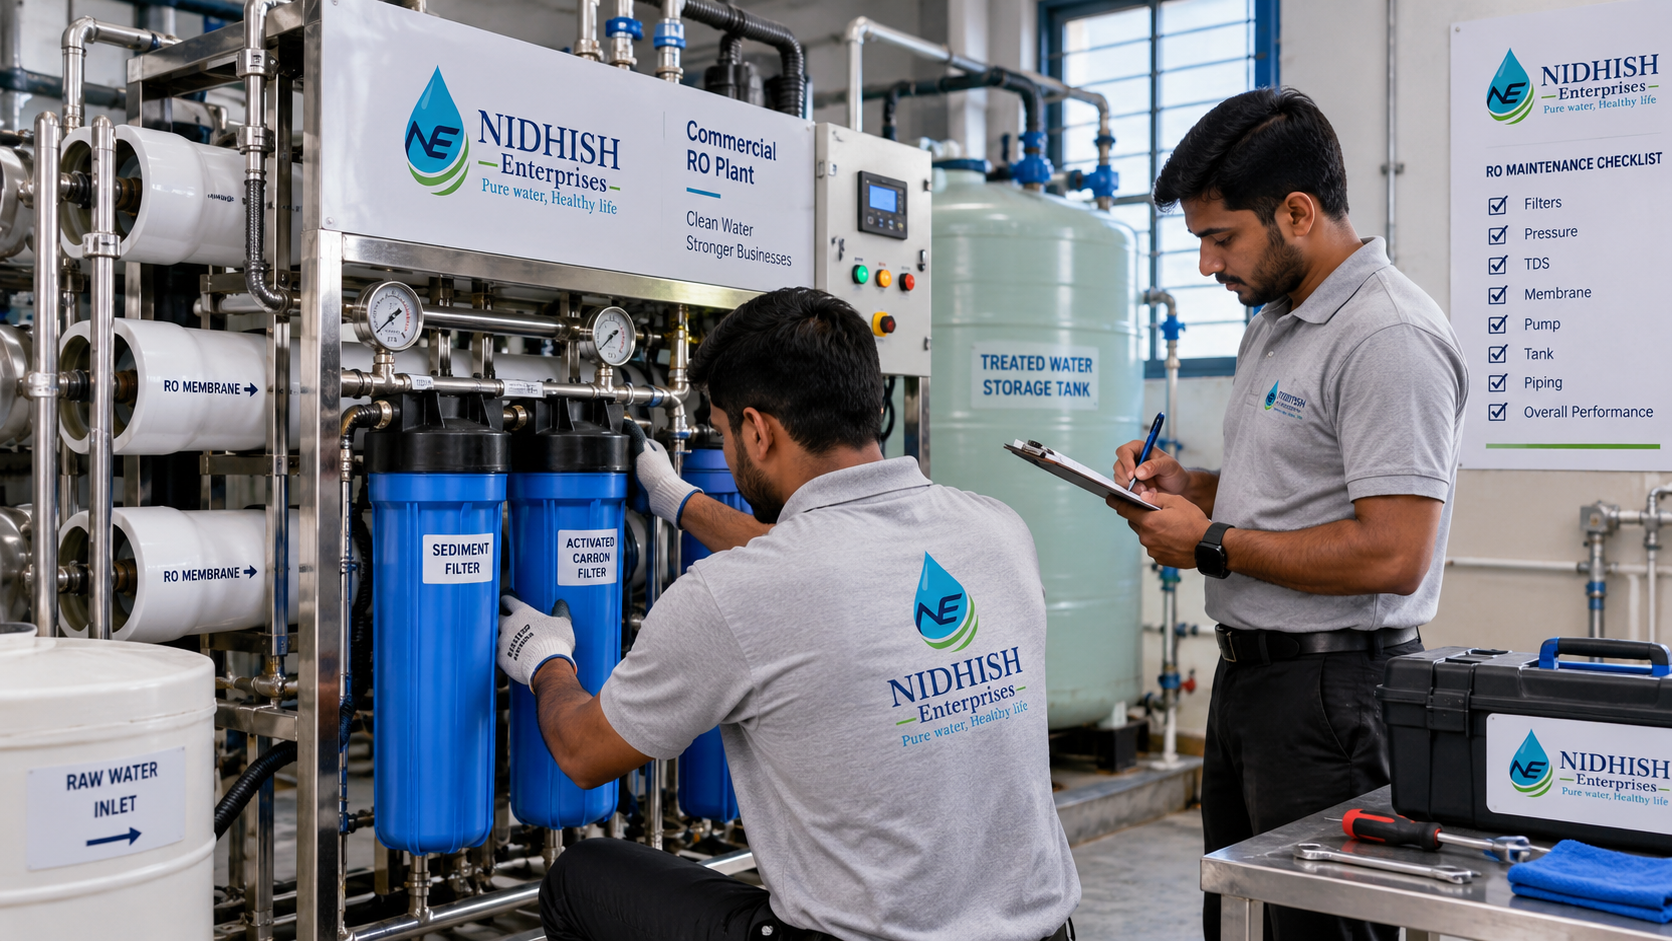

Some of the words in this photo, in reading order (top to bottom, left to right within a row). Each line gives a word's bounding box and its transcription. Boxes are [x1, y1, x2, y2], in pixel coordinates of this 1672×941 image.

[1541, 53, 1659, 86] NIDHISH
[1558, 81, 1646, 100] Enterprises
[1543, 104, 1565, 114] Pure
[1568, 102, 1596, 112] water,
[1599, 97, 1637, 109] Healthy
[1640, 95, 1657, 105] life
[478, 109, 620, 170] NIDHISH
[687, 120, 777, 161] Commercial
[501, 152, 607, 192] Enterprises
[687, 149, 710, 174] RO
[716, 156, 754, 184] Plant
[1486, 165, 1503, 178] RO
[1506, 157, 1594, 176] MAINTENANCE
[1597, 152, 1662, 169] CHECKLIST
[482, 178, 509, 196] Pure
[513, 186, 548, 205] water,
[551, 190, 596, 214] Healthy
[599, 198, 617, 214] life
[1525, 197, 1562, 210] Filters
[686, 210, 718, 230] Clean
[721, 217, 753, 237] Water
[1525, 227, 1578, 240] Pressure
[686, 235, 734, 259] Stronger
[737, 243, 792, 267] Businesses
[1524, 257, 1550, 270] TDS
[1525, 287, 1592, 300] Membrane
[1525, 318, 1561, 332] Pump
[1524, 347, 1554, 360] Tank
[981, 354, 1045, 371] TREATED
[1049, 356, 1093, 373] WATER
[164, 380, 179, 392] RO
[182, 381, 240, 395] MEMBRANE
[983, 379, 1052, 396] STORAGE
[1056, 381, 1090, 397] TANK
[1525, 376, 1563, 391] Piping
[1524, 406, 1568, 418] Overall
[1572, 405, 1654, 418] Performance
[432, 542, 489, 556] SEDIMENT
[566, 537, 614, 548] ACTIVATED
[163, 570, 179, 582] RO
[182, 567, 240, 581] MEMBRANE
[445, 562, 480, 575] FILTER
[578, 567, 606, 578] FILTER
[887, 646, 1023, 708] NIDHISH
[918, 684, 1015, 724] Enterprises
[901, 731, 931, 747] Pure
[934, 721, 968, 738] water,
[970, 708, 1011, 728] Healthy
[1013, 700, 1028, 716] life
[1559, 750, 1670, 779] NIDHISH
[66, 769, 104, 791] RAW
[108, 761, 158, 785] WATER
[1576, 773, 1657, 792] Enterprises
[1561, 786, 1583, 797] Pure
[1585, 790, 1612, 801] water,
[1613, 792, 1650, 806] Healthy
[1653, 796, 1669, 806] life
[94, 794, 137, 818] INLET
